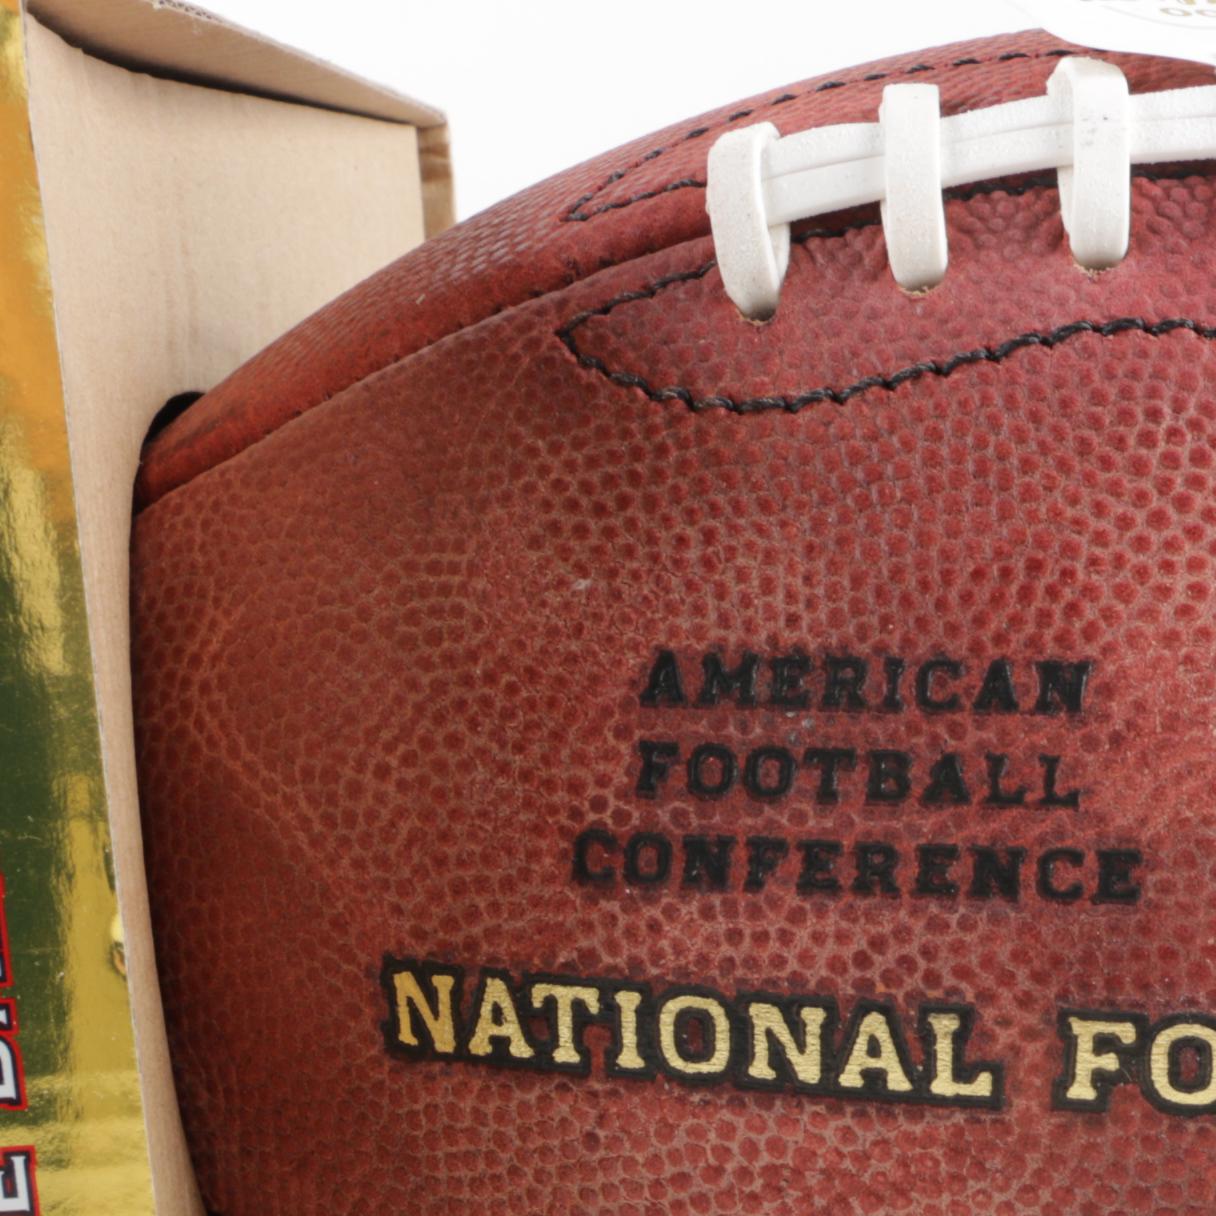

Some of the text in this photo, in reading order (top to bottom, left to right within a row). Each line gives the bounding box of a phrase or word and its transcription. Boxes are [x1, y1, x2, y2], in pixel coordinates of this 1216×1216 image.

[637, 648, 1092, 717] AMERICAN
[635, 740, 1083, 811] FOOTBALL
[571, 828, 1145, 905] CONFERENCE
[386, 963, 998, 1103] NATIONAL
